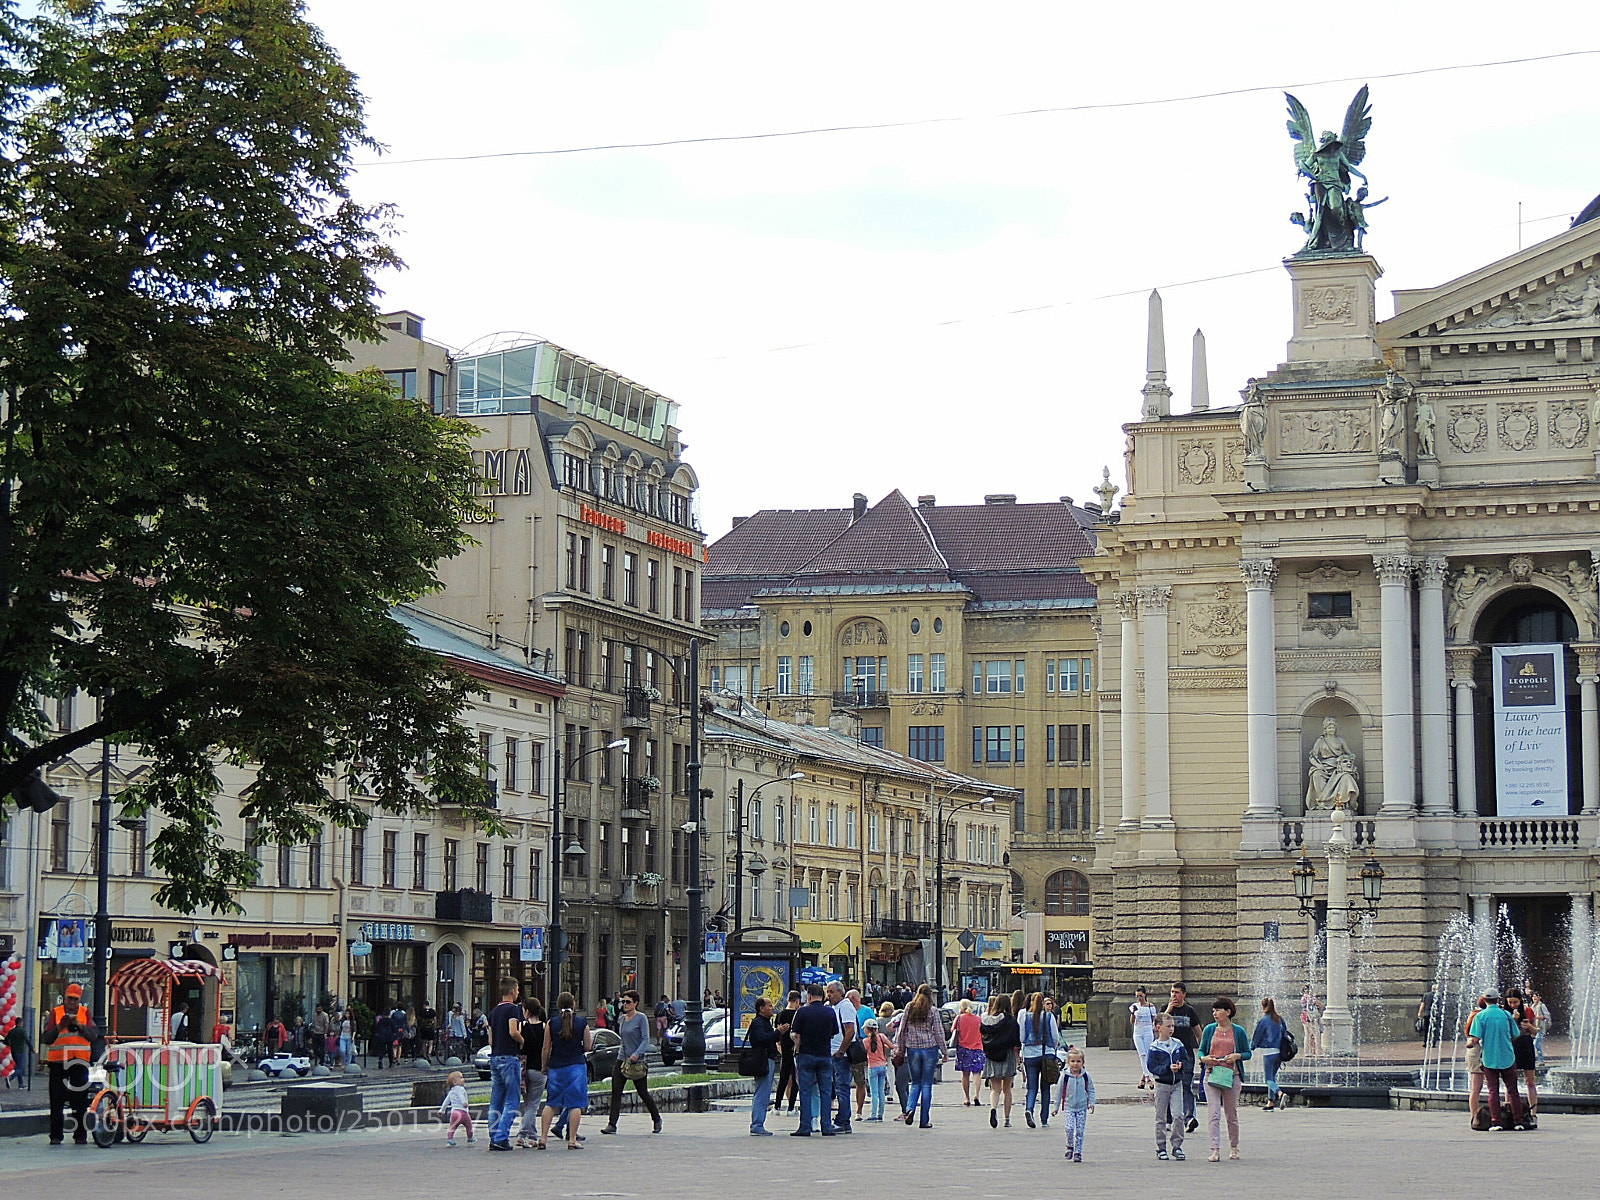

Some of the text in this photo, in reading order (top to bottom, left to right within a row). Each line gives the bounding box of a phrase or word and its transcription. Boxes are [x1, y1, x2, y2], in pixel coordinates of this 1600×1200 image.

[450, 500, 494, 524] otel
[1509, 677, 1548, 685] LEOPOLIS
[1505, 712, 1541, 723] Luxury
[1505, 726, 1562, 737] in the heart
[1505, 740, 1542, 753] of Lviv
[112, 927, 156, 943] ОПТИКА
